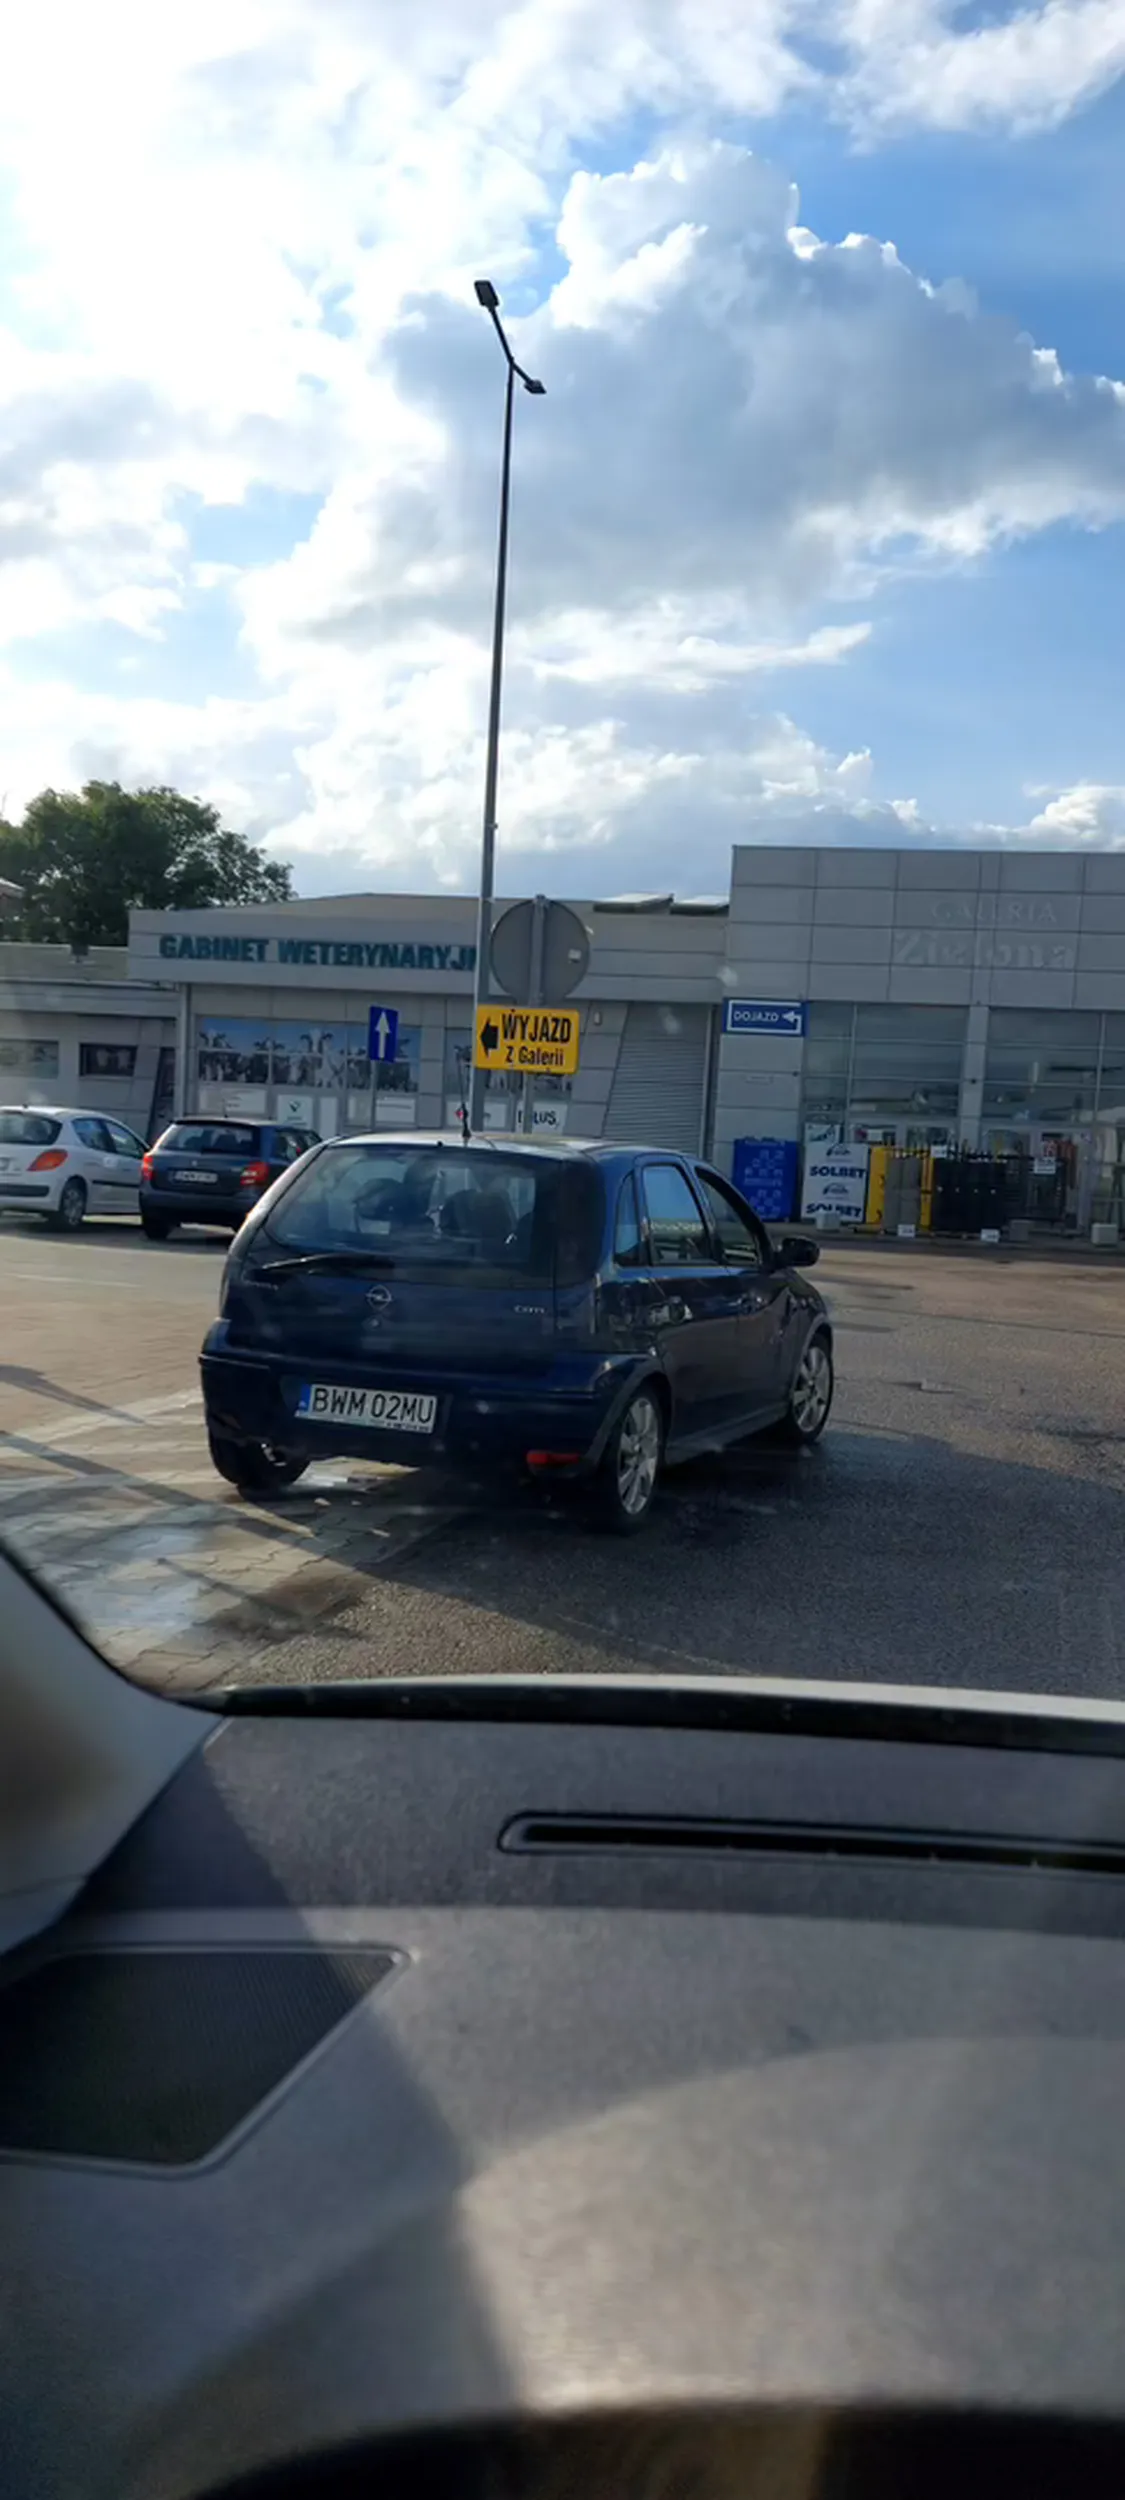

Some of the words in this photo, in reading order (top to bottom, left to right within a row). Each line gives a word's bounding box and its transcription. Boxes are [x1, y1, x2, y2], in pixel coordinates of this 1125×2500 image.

[157, 934, 269, 962] GABINET
[892, 932, 1076, 968] Zielona
[500, 1012, 571, 1044] WYJAZD
[733, 1010, 779, 1022] DOJAZD
[517, 1046, 564, 1067] Galerii
[809, 1165, 866, 1179] SOLBET
[312, 1387, 366, 1417] BWM
[371, 1393, 433, 1424] 02MU
